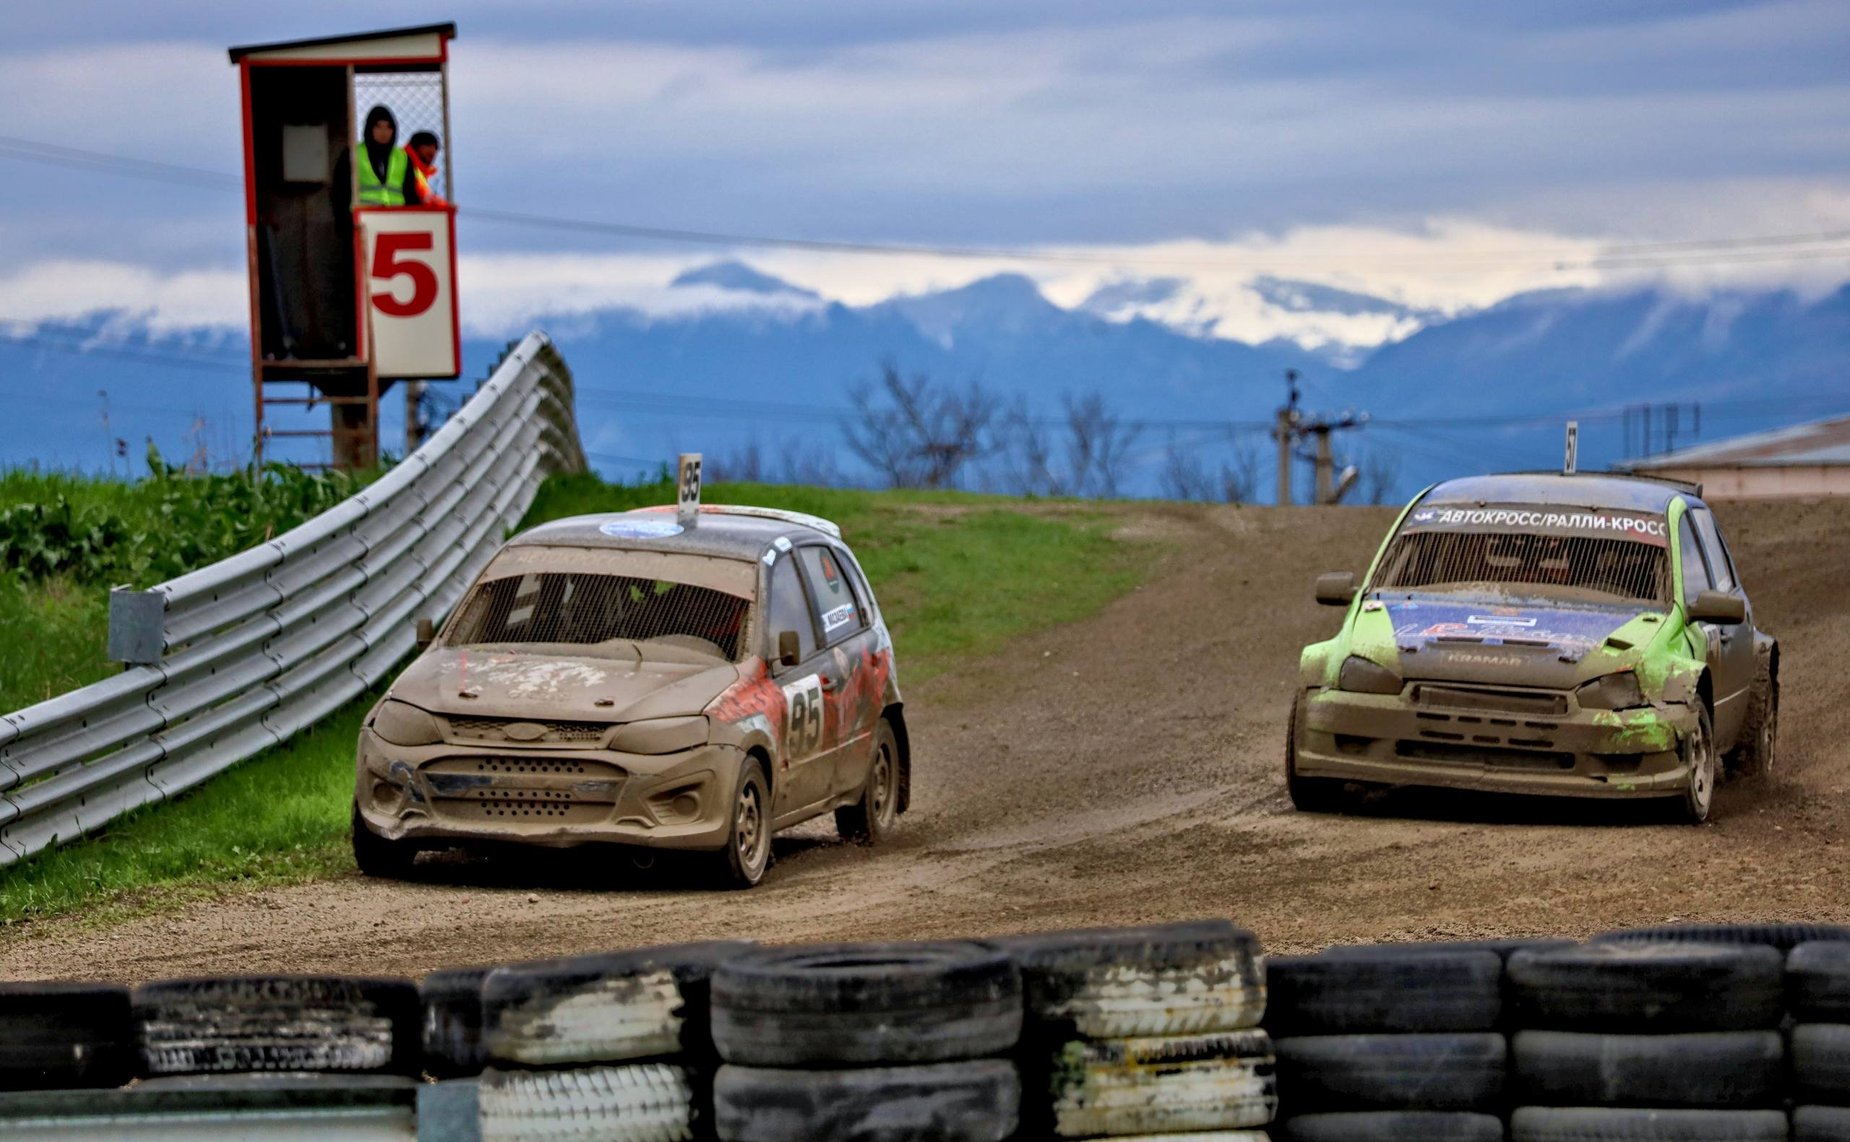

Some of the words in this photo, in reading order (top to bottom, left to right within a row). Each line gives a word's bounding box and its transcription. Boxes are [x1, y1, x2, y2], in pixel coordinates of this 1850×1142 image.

[371, 231, 439, 318] 5
[681, 461, 700, 502] 95
[1437, 509, 1665, 537] АВТОКРОСС/РАЛЛИ-КРОСС
[789, 687, 821, 757] 95
